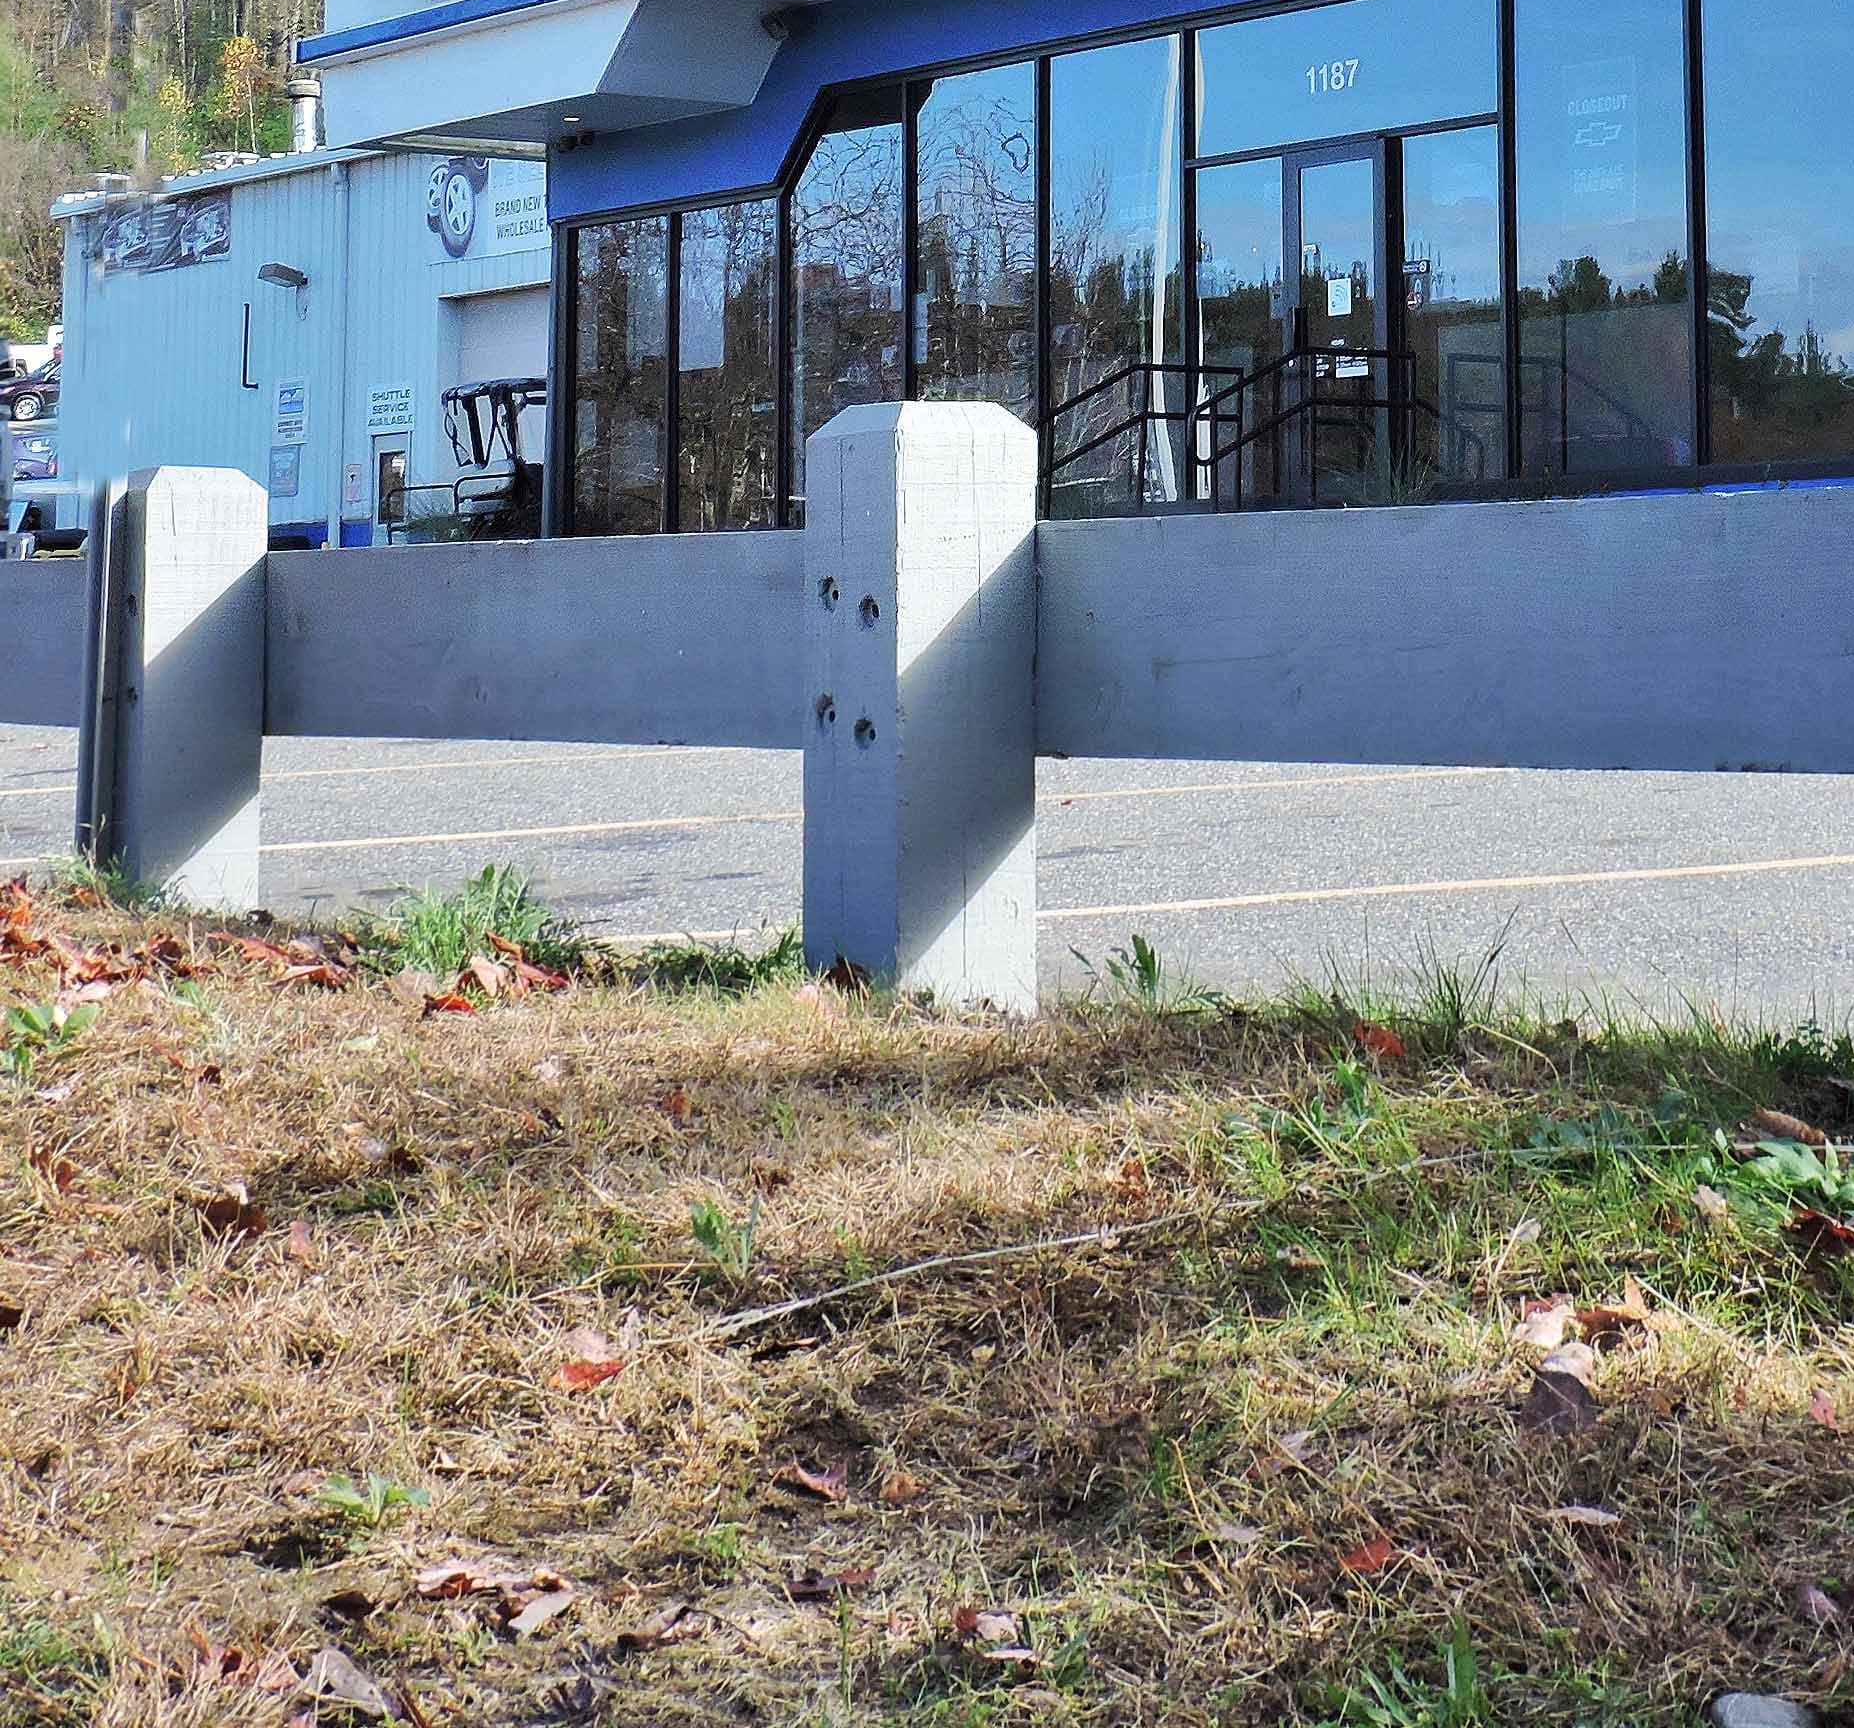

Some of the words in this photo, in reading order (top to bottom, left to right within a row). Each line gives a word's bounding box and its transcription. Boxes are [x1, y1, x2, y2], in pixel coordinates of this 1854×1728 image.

[1304, 58, 1360, 95] 1187
[1567, 93, 1628, 116] CLOSEOUT
[495, 198, 521, 217] BRAND
[523, 194, 541, 212] NEW
[496, 217, 544, 240] WHOLESALE
[371, 388, 411, 402] SHUTTLE
[372, 402, 409, 415] SERVICE
[367, 414, 413, 427] AVAILABLE
